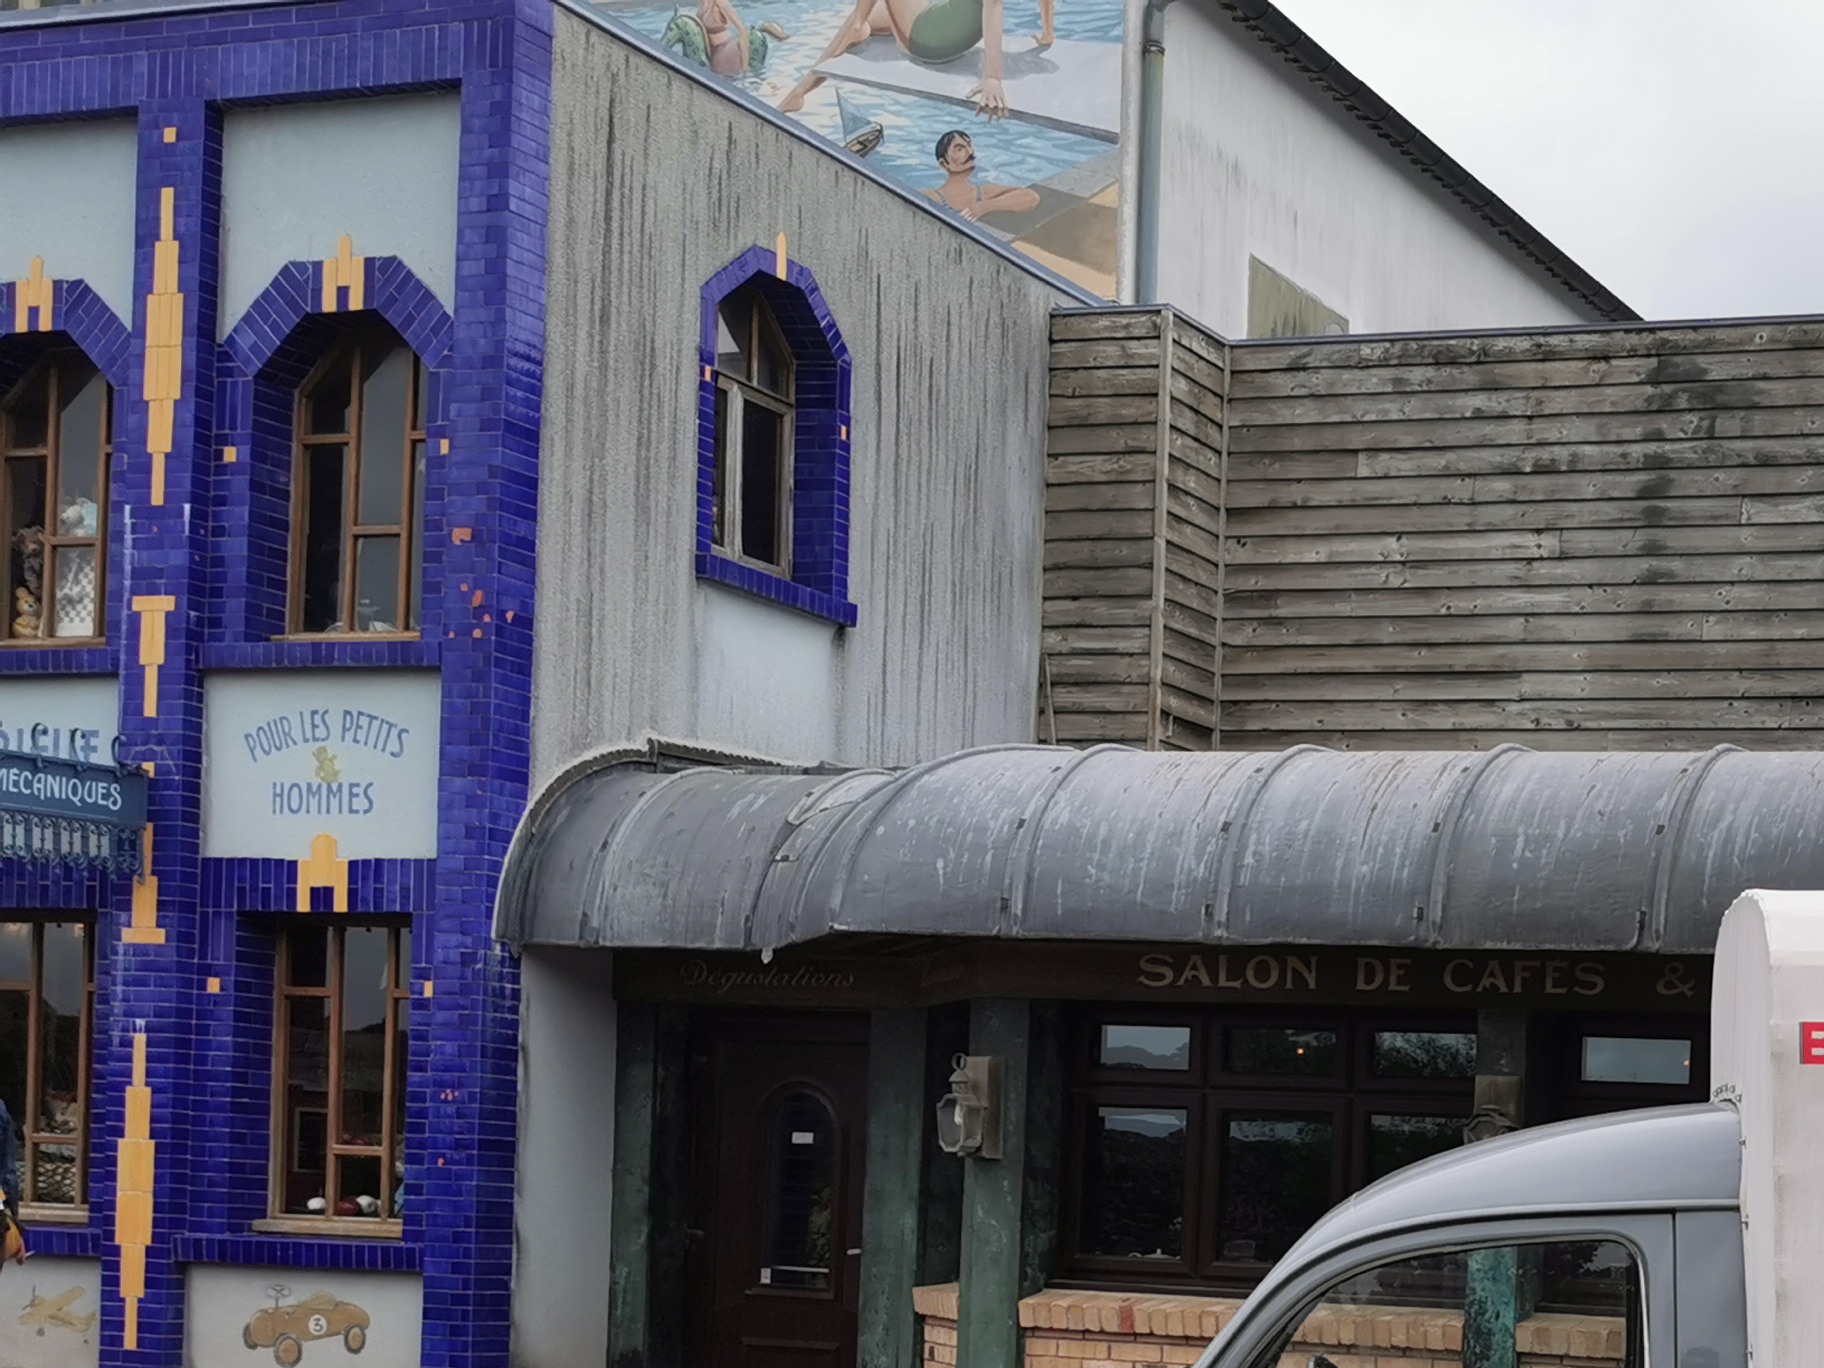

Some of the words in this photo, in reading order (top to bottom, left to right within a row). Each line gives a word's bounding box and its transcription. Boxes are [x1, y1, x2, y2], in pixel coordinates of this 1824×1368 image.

[243, 716, 298, 763] POUR
[299, 709, 331, 743] LES
[341, 709, 410, 759] PETITS
[272, 781, 374, 815] HOMMES
[1137, 954, 1318, 990] SALON
[1355, 957, 1412, 993] DE
[1656, 961, 1696, 996] &
[312, 1317, 324, 1333] 3
